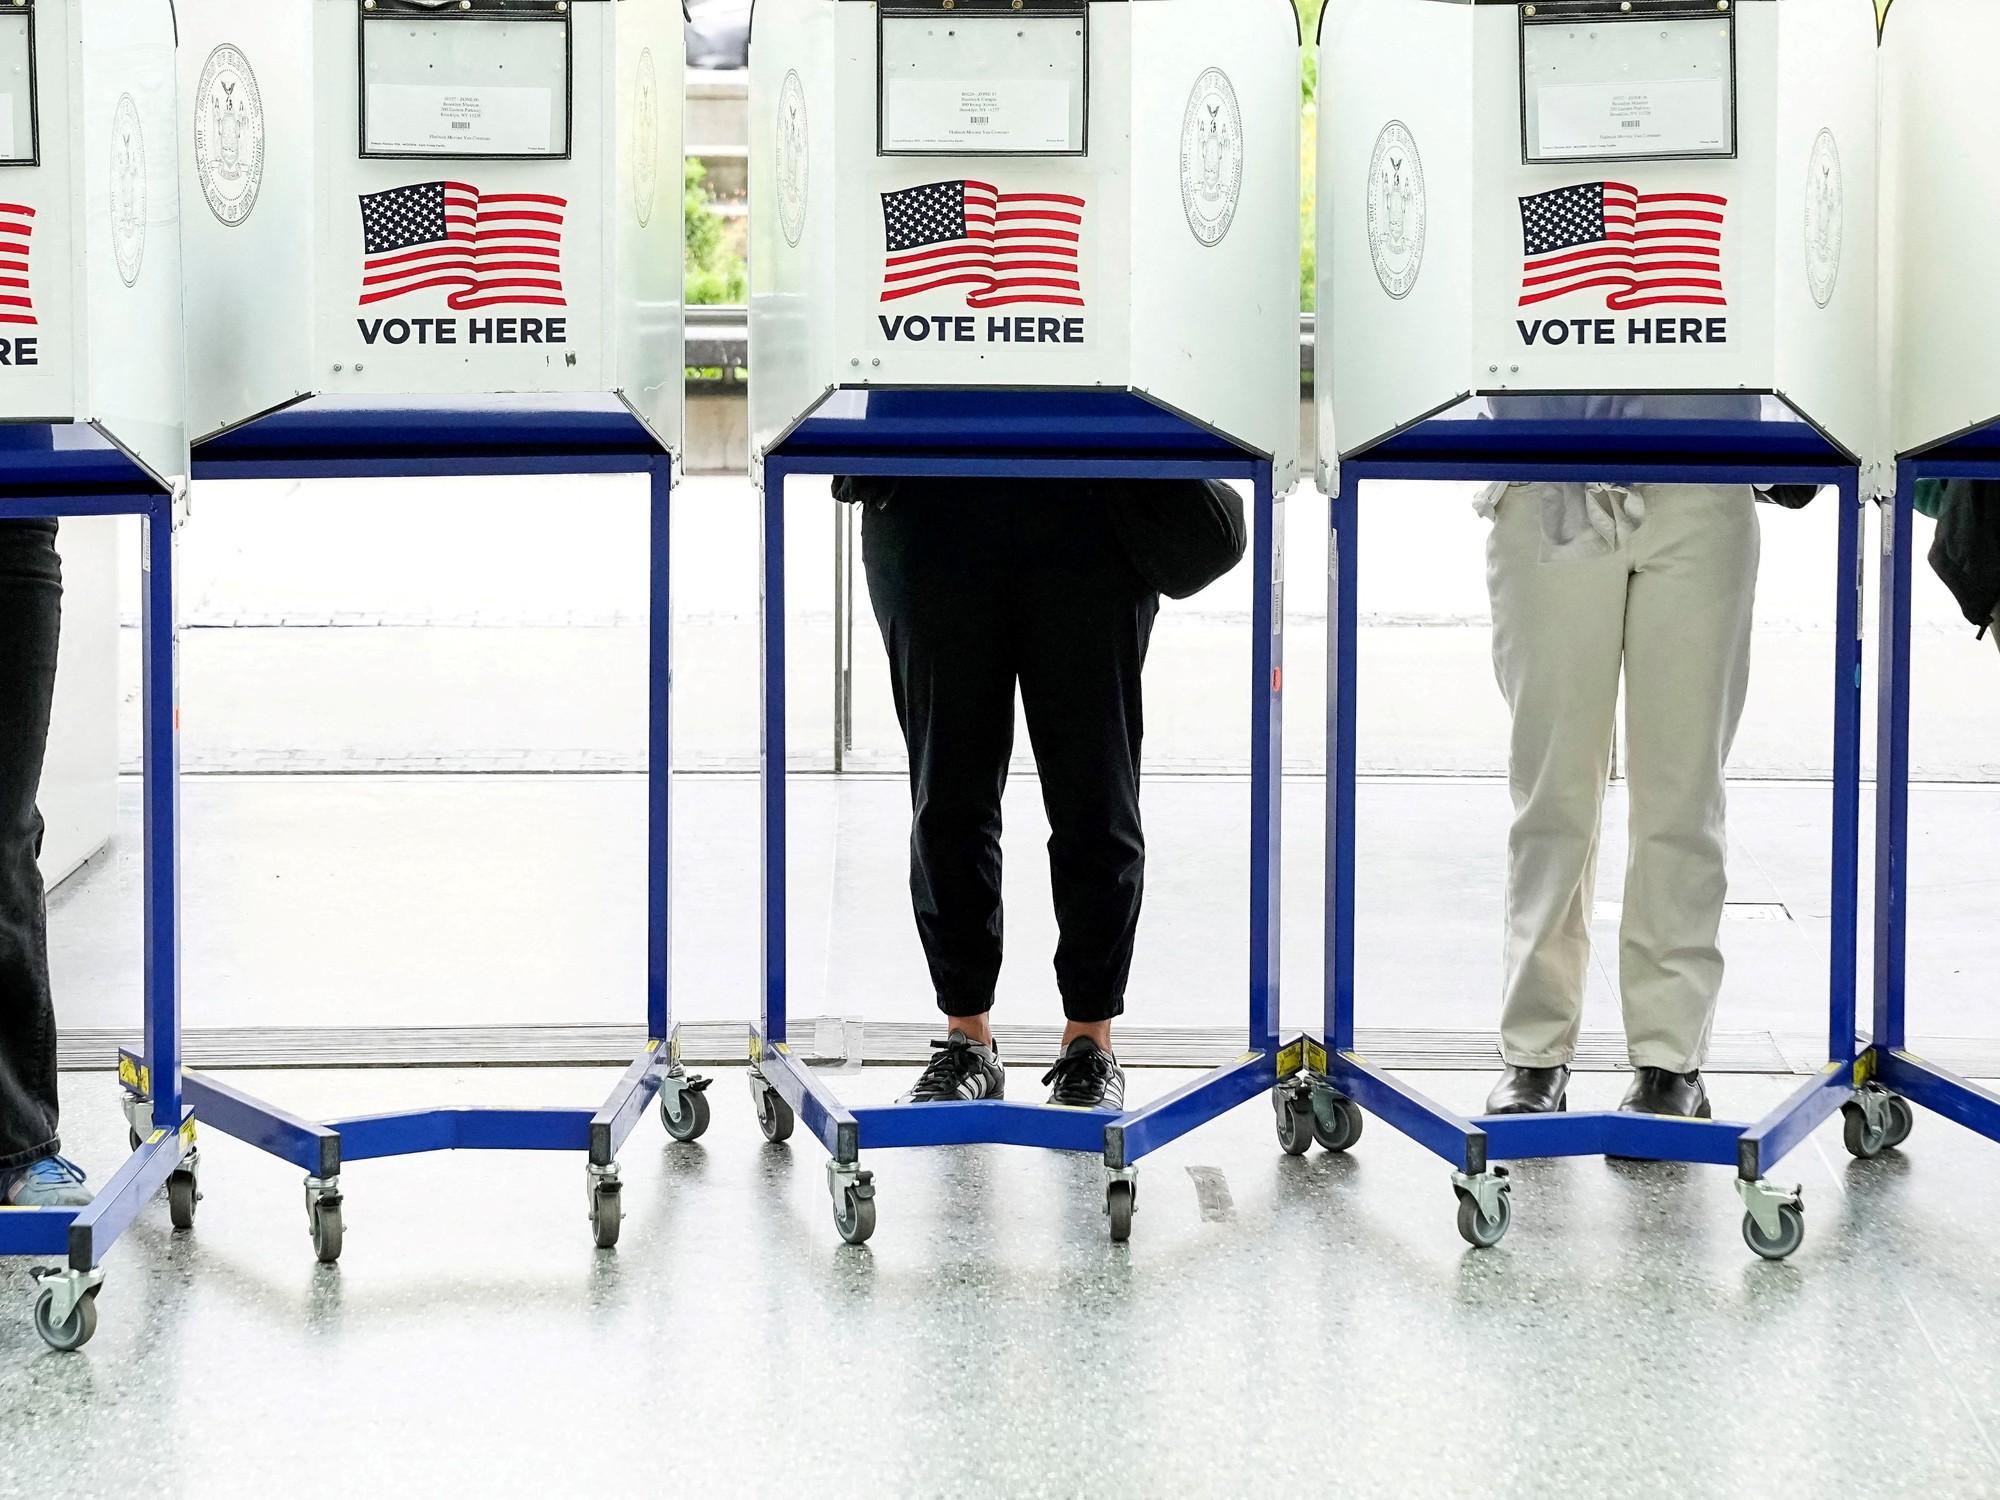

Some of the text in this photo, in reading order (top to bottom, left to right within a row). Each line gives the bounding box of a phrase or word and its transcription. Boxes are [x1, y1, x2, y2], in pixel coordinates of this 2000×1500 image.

[357, 317, 567, 345] VOTE HERE
[877, 315, 1084, 343] VOTE HERE
[1516, 317, 1727, 346] VOTE HERE
[0, 337, 38, 365] RE
